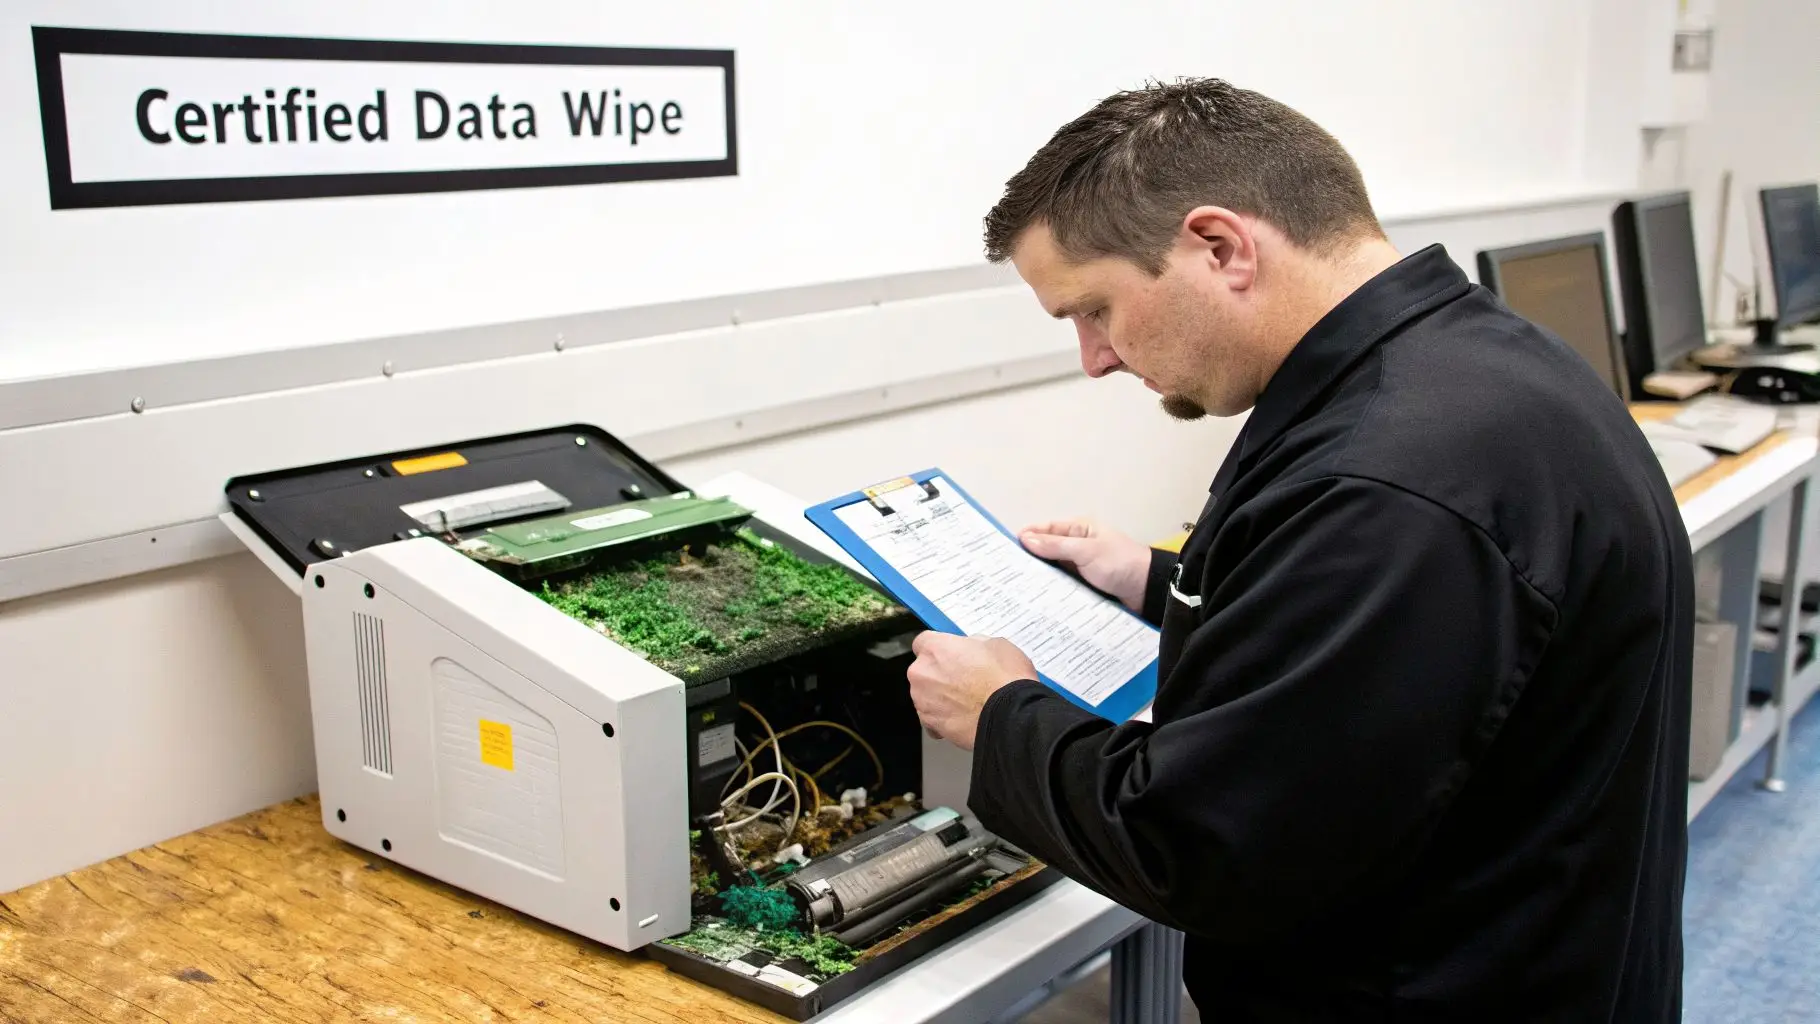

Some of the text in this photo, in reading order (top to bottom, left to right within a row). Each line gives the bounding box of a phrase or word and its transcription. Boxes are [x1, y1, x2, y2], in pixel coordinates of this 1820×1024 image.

[136, 88, 682, 145] Certified Data Wipe
